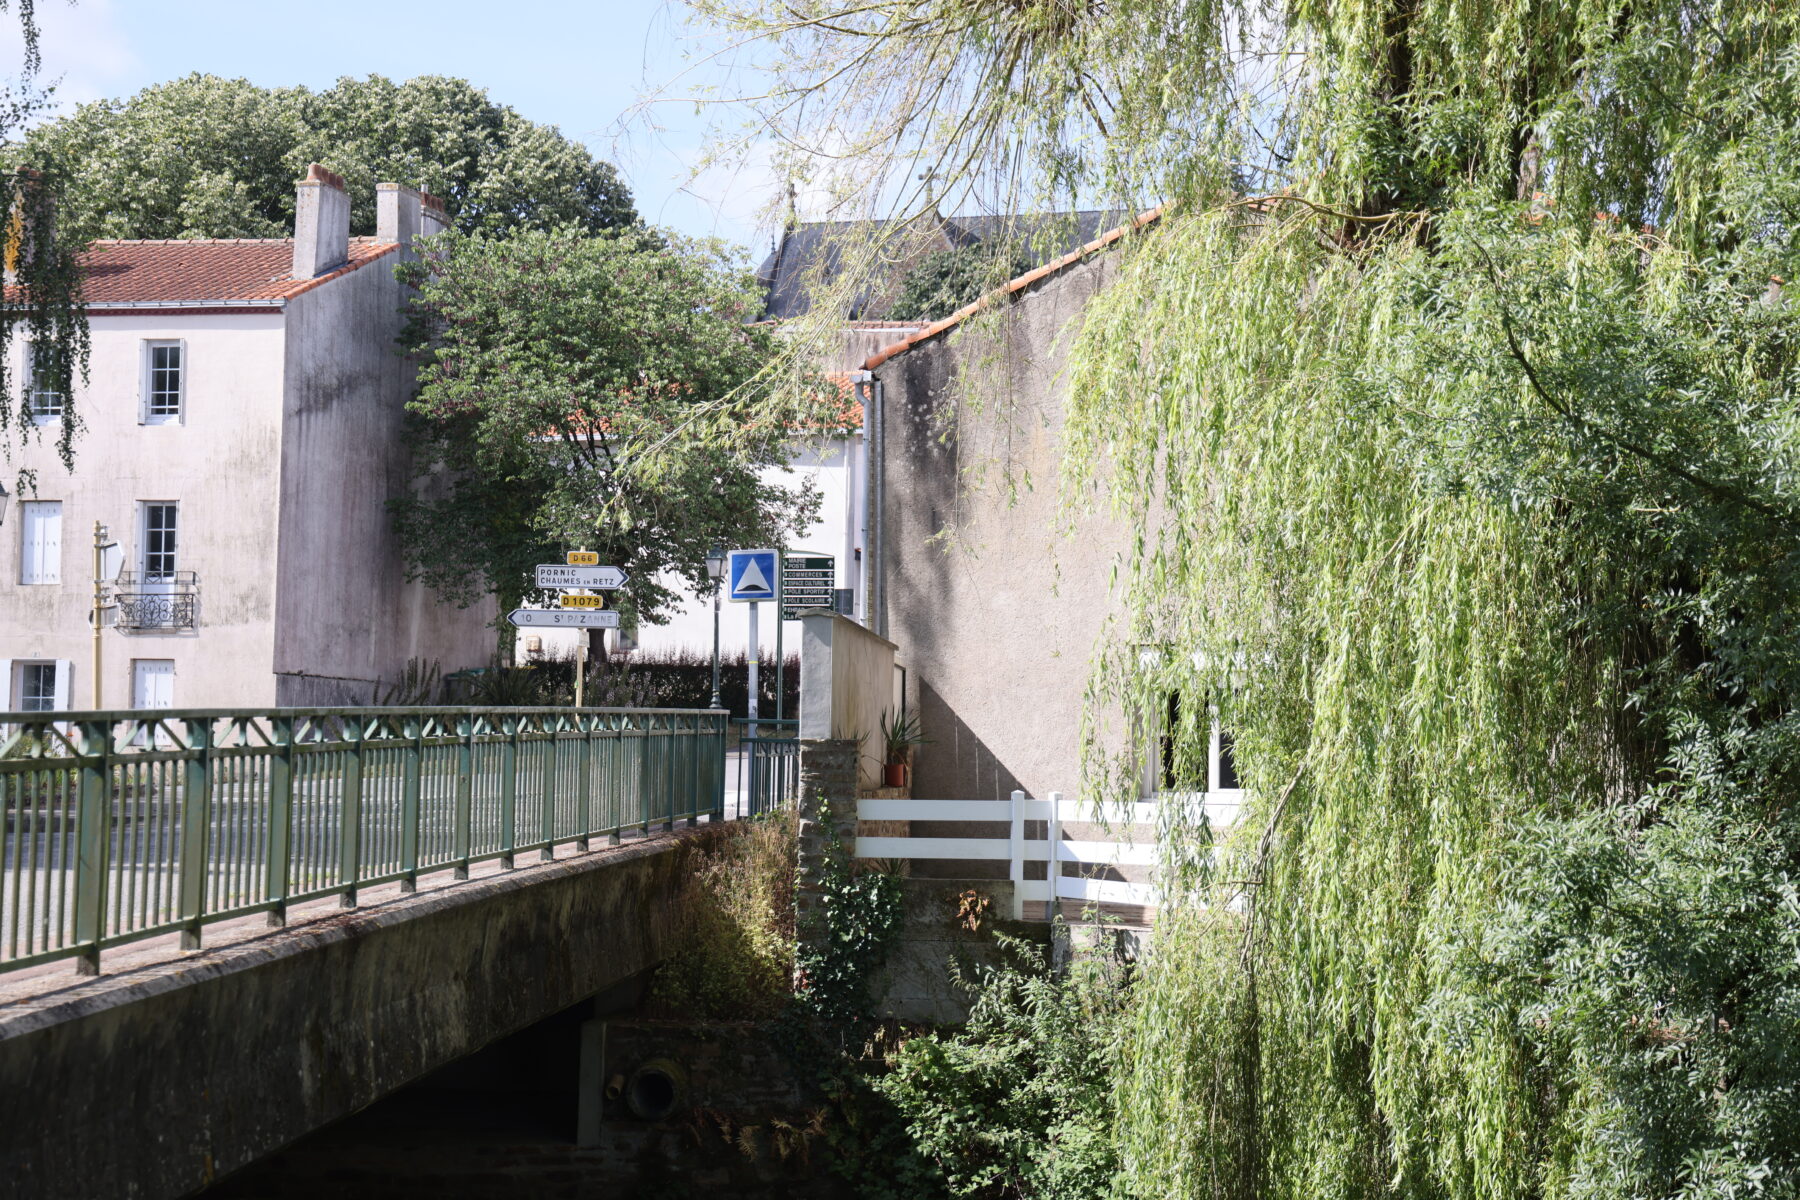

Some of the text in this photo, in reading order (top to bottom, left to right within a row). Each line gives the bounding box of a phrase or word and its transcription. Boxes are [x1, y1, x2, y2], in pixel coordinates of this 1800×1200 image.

[540, 577, 580, 585] CHAUMES
[593, 578, 614, 586] RETZ
[521, 614, 532, 623] 10
